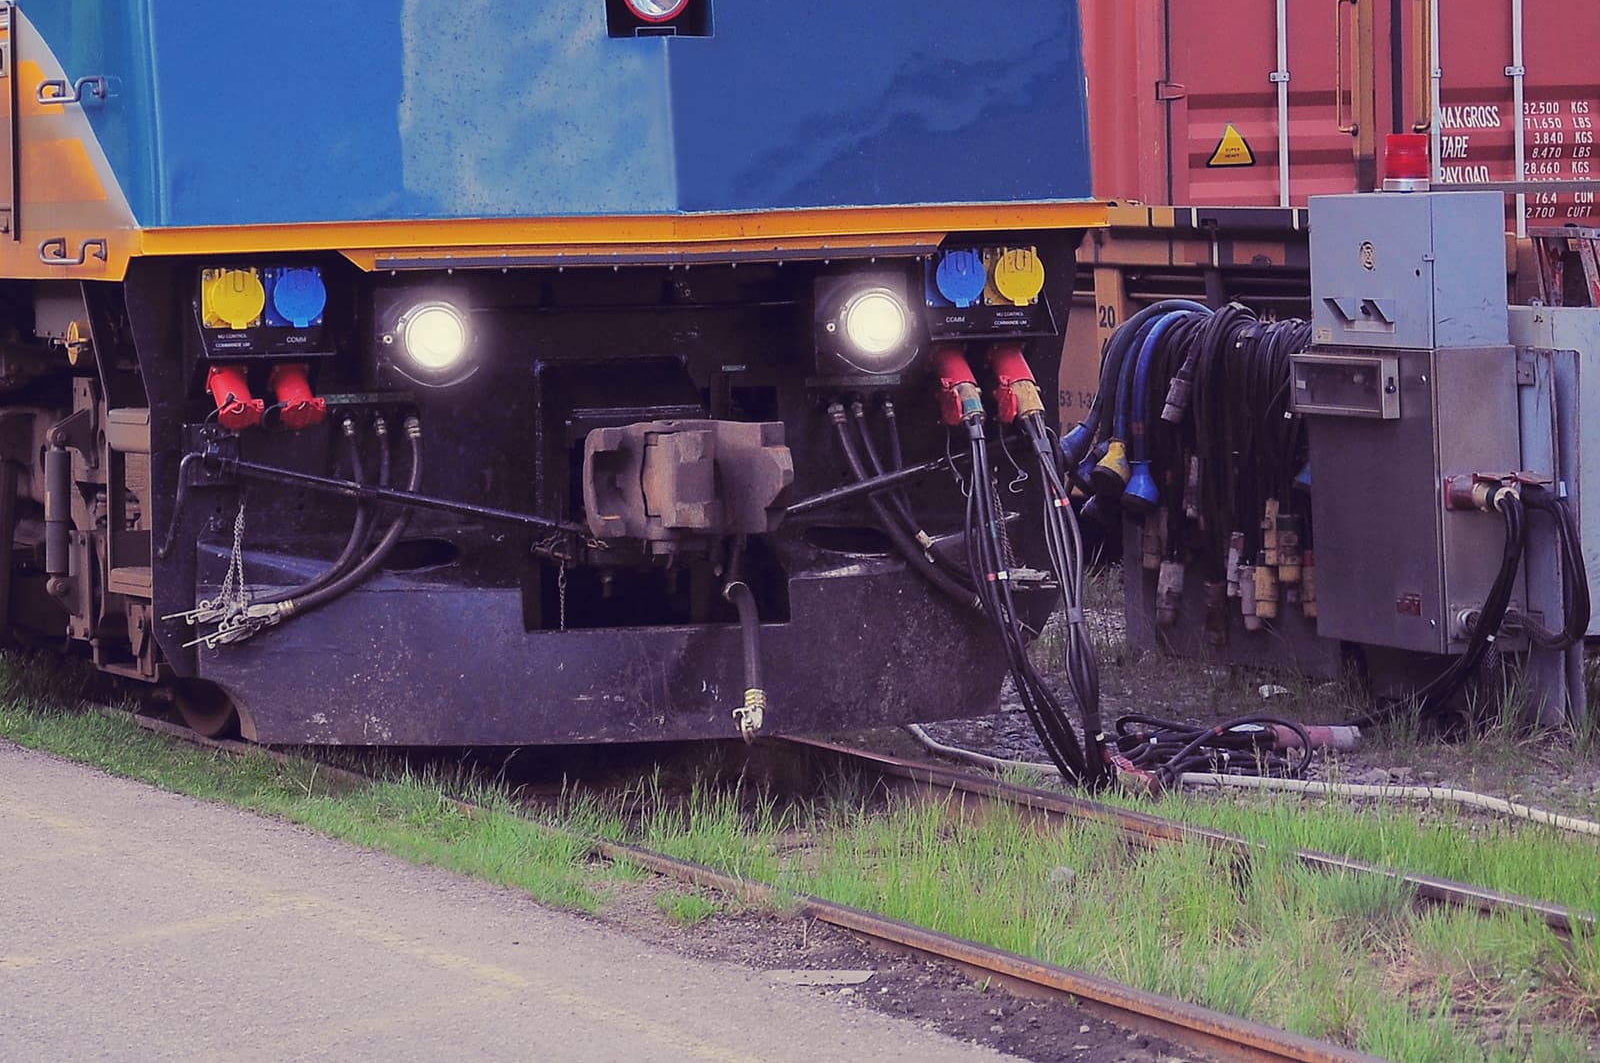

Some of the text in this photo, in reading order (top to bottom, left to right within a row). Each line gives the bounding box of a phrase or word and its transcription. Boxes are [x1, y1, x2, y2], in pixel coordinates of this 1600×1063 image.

[1523, 101, 1589, 115] 32.500 KGS
[1524, 117, 1592, 130] 71.650 LBS
[1534, 131, 1594, 145] 3.840 KGS
[1441, 135, 1470, 159] TARE
[1532, 146, 1592, 159] 8.470 LBS
[1439, 165, 1490, 184] PAYLOAD
[1524, 161, 1590, 175] 28.660 KGS
[1535, 192, 1557, 204] 76.4
[1526, 206, 1593, 218] 2.700 CUFT
[1098, 305, 1116, 329] 20
